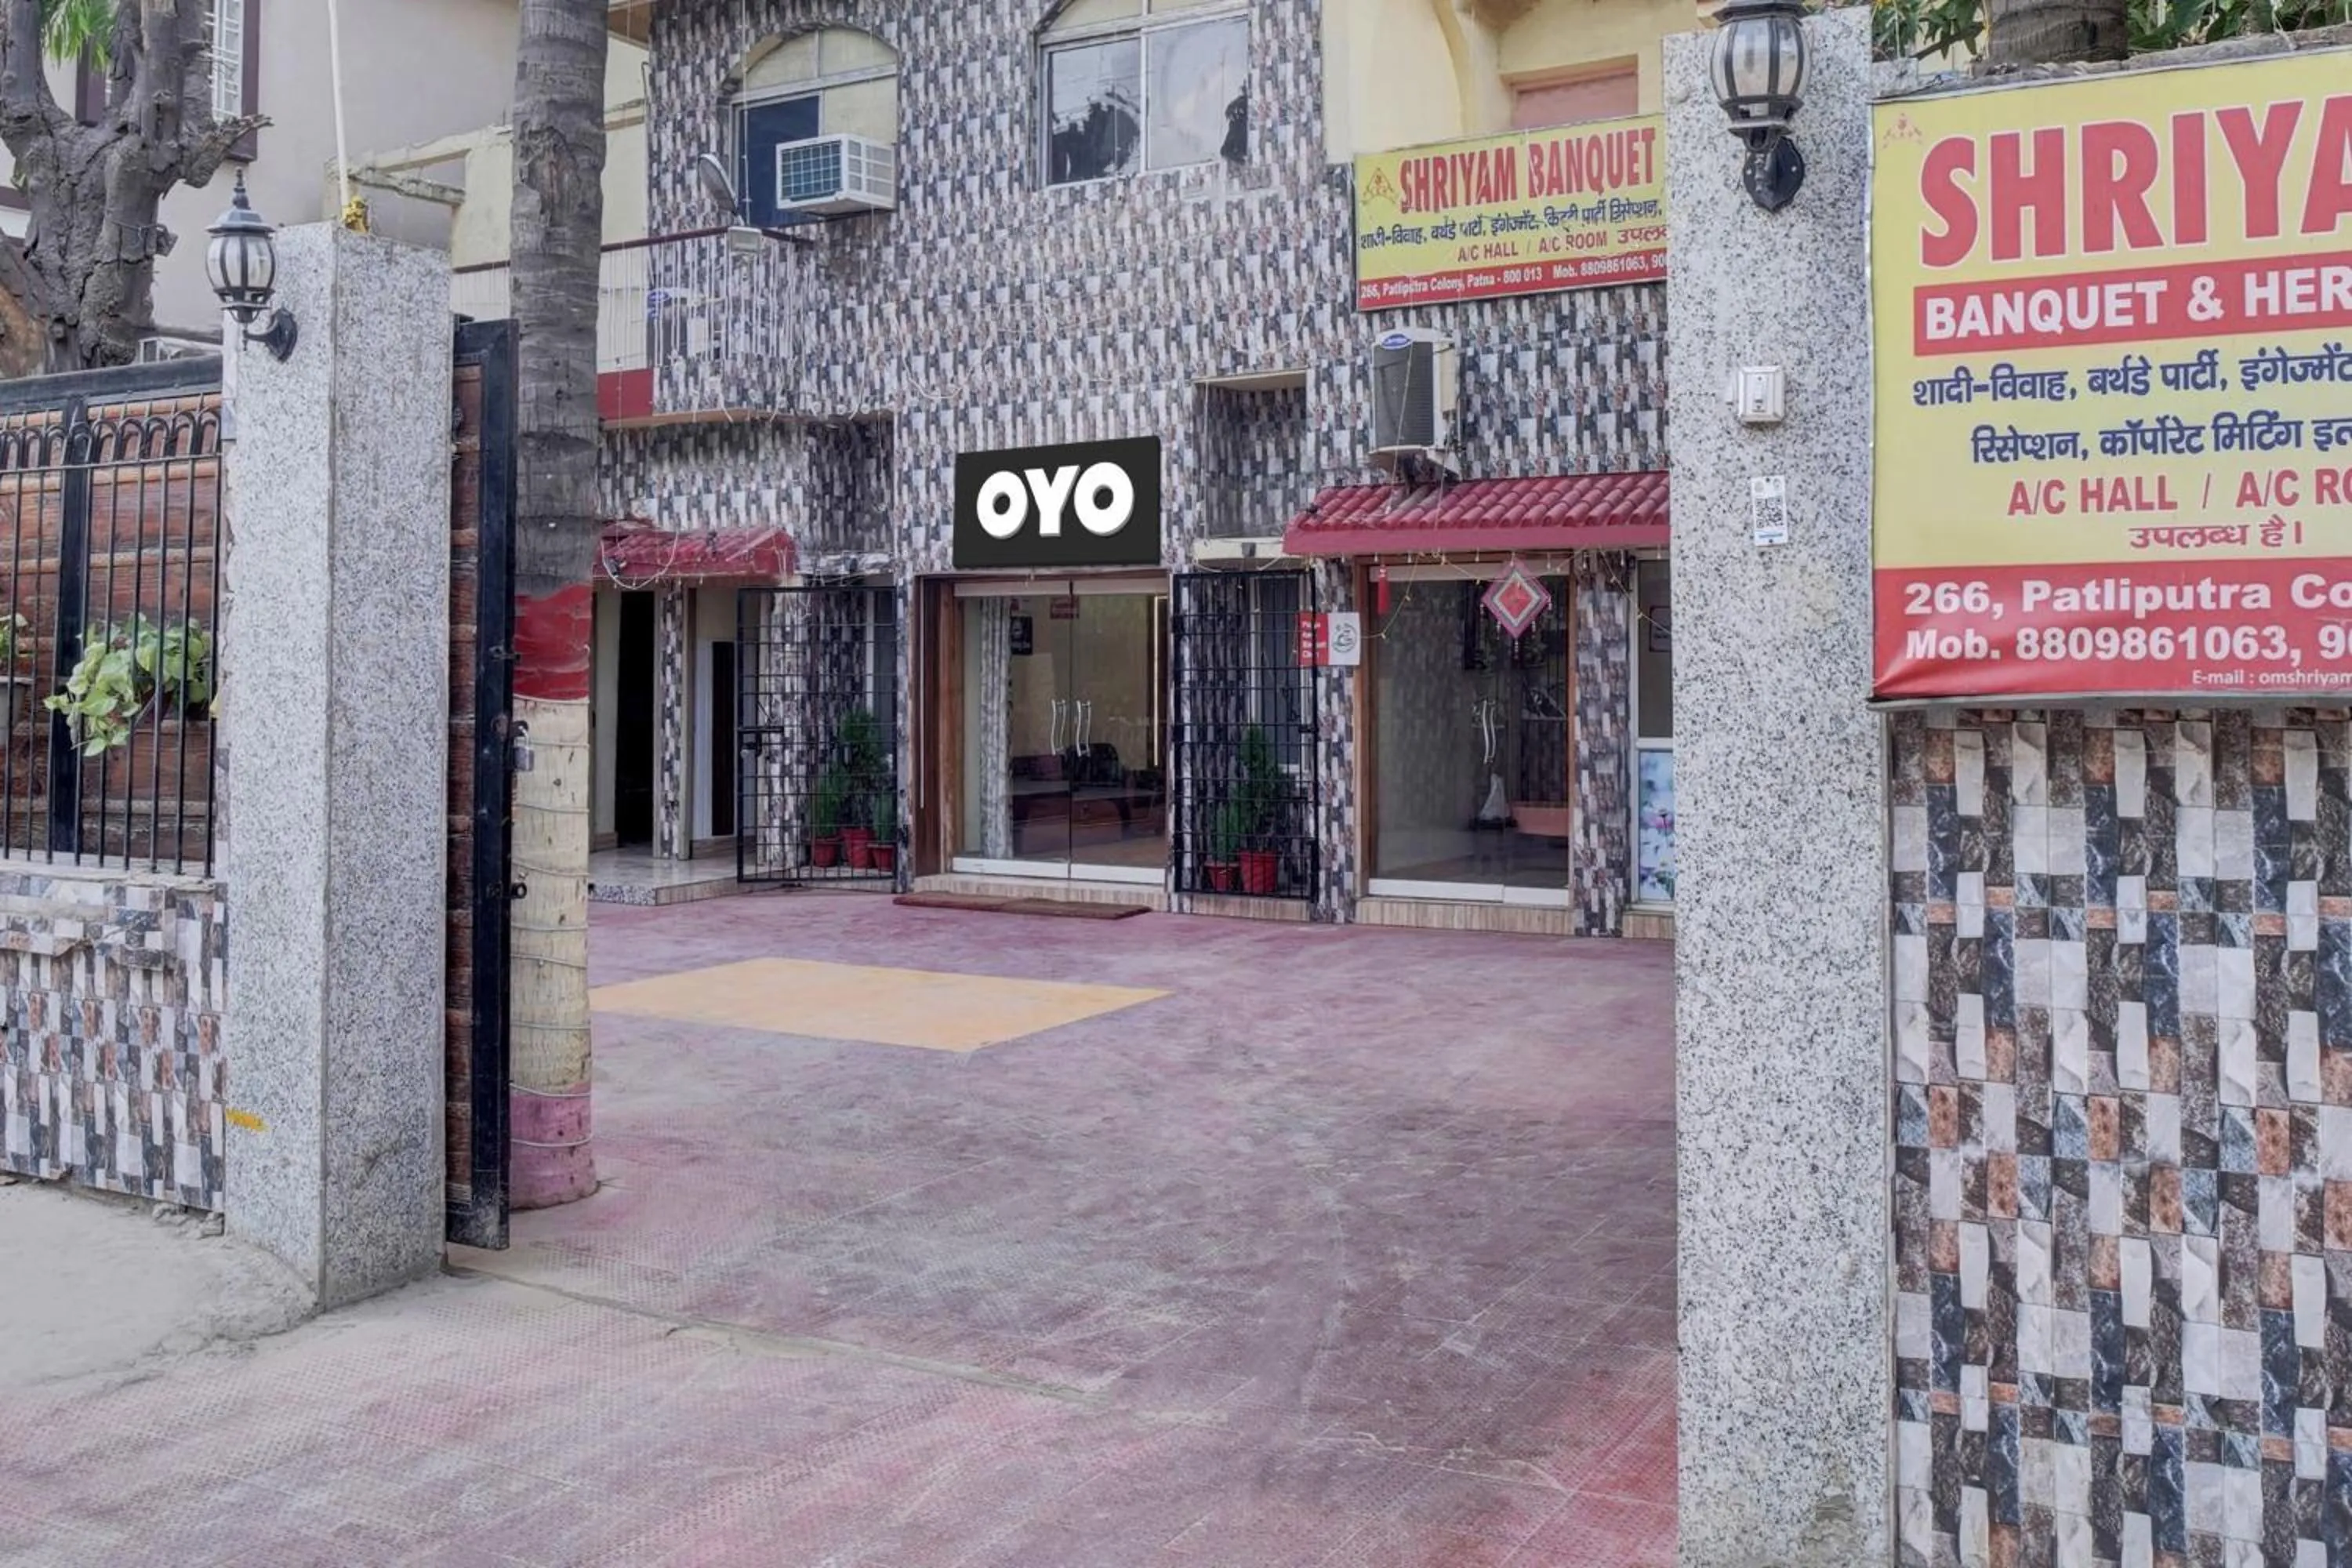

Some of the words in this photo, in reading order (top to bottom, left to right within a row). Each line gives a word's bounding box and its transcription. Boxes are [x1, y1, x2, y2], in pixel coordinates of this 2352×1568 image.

[1399, 147, 1517, 213] SHRIYAM
[1529, 127, 1655, 199] BANQUET
[1484, 241, 1519, 260] HALL
[1566, 231, 1608, 251] ROOM
[1467, 274, 1495, 288] Patna
[1523, 267, 1543, 282] 013
[1926, 280, 2168, 339] BANQUET
[2187, 276, 2224, 321] &
[1913, 363, 2077, 405] शादी-विवाह,
[2087, 354, 2151, 395] बर्थडे
[2160, 348, 2227, 391] पार्टी,
[1971, 424, 2089, 463] रिसेप्शन,
[2099, 415, 2205, 456] कॉर्पोरेट
[2212, 409, 2303, 452] मिटिंग
[976, 462, 1134, 539] OYO
[2007, 479, 2067, 516] A/C
[2080, 474, 2178, 514] HALL
[2236, 469, 2299, 507] A/C
[2128, 524, 2250, 549] उपलब्ध
[1904, 581, 2004, 619] 266,
[2022, 577, 2271, 619] Patliputra
[1906, 628, 2001, 659] Mob.
[2016, 625, 2301, 667] 8809861063,
[2192, 670, 2245, 684] E-mail
